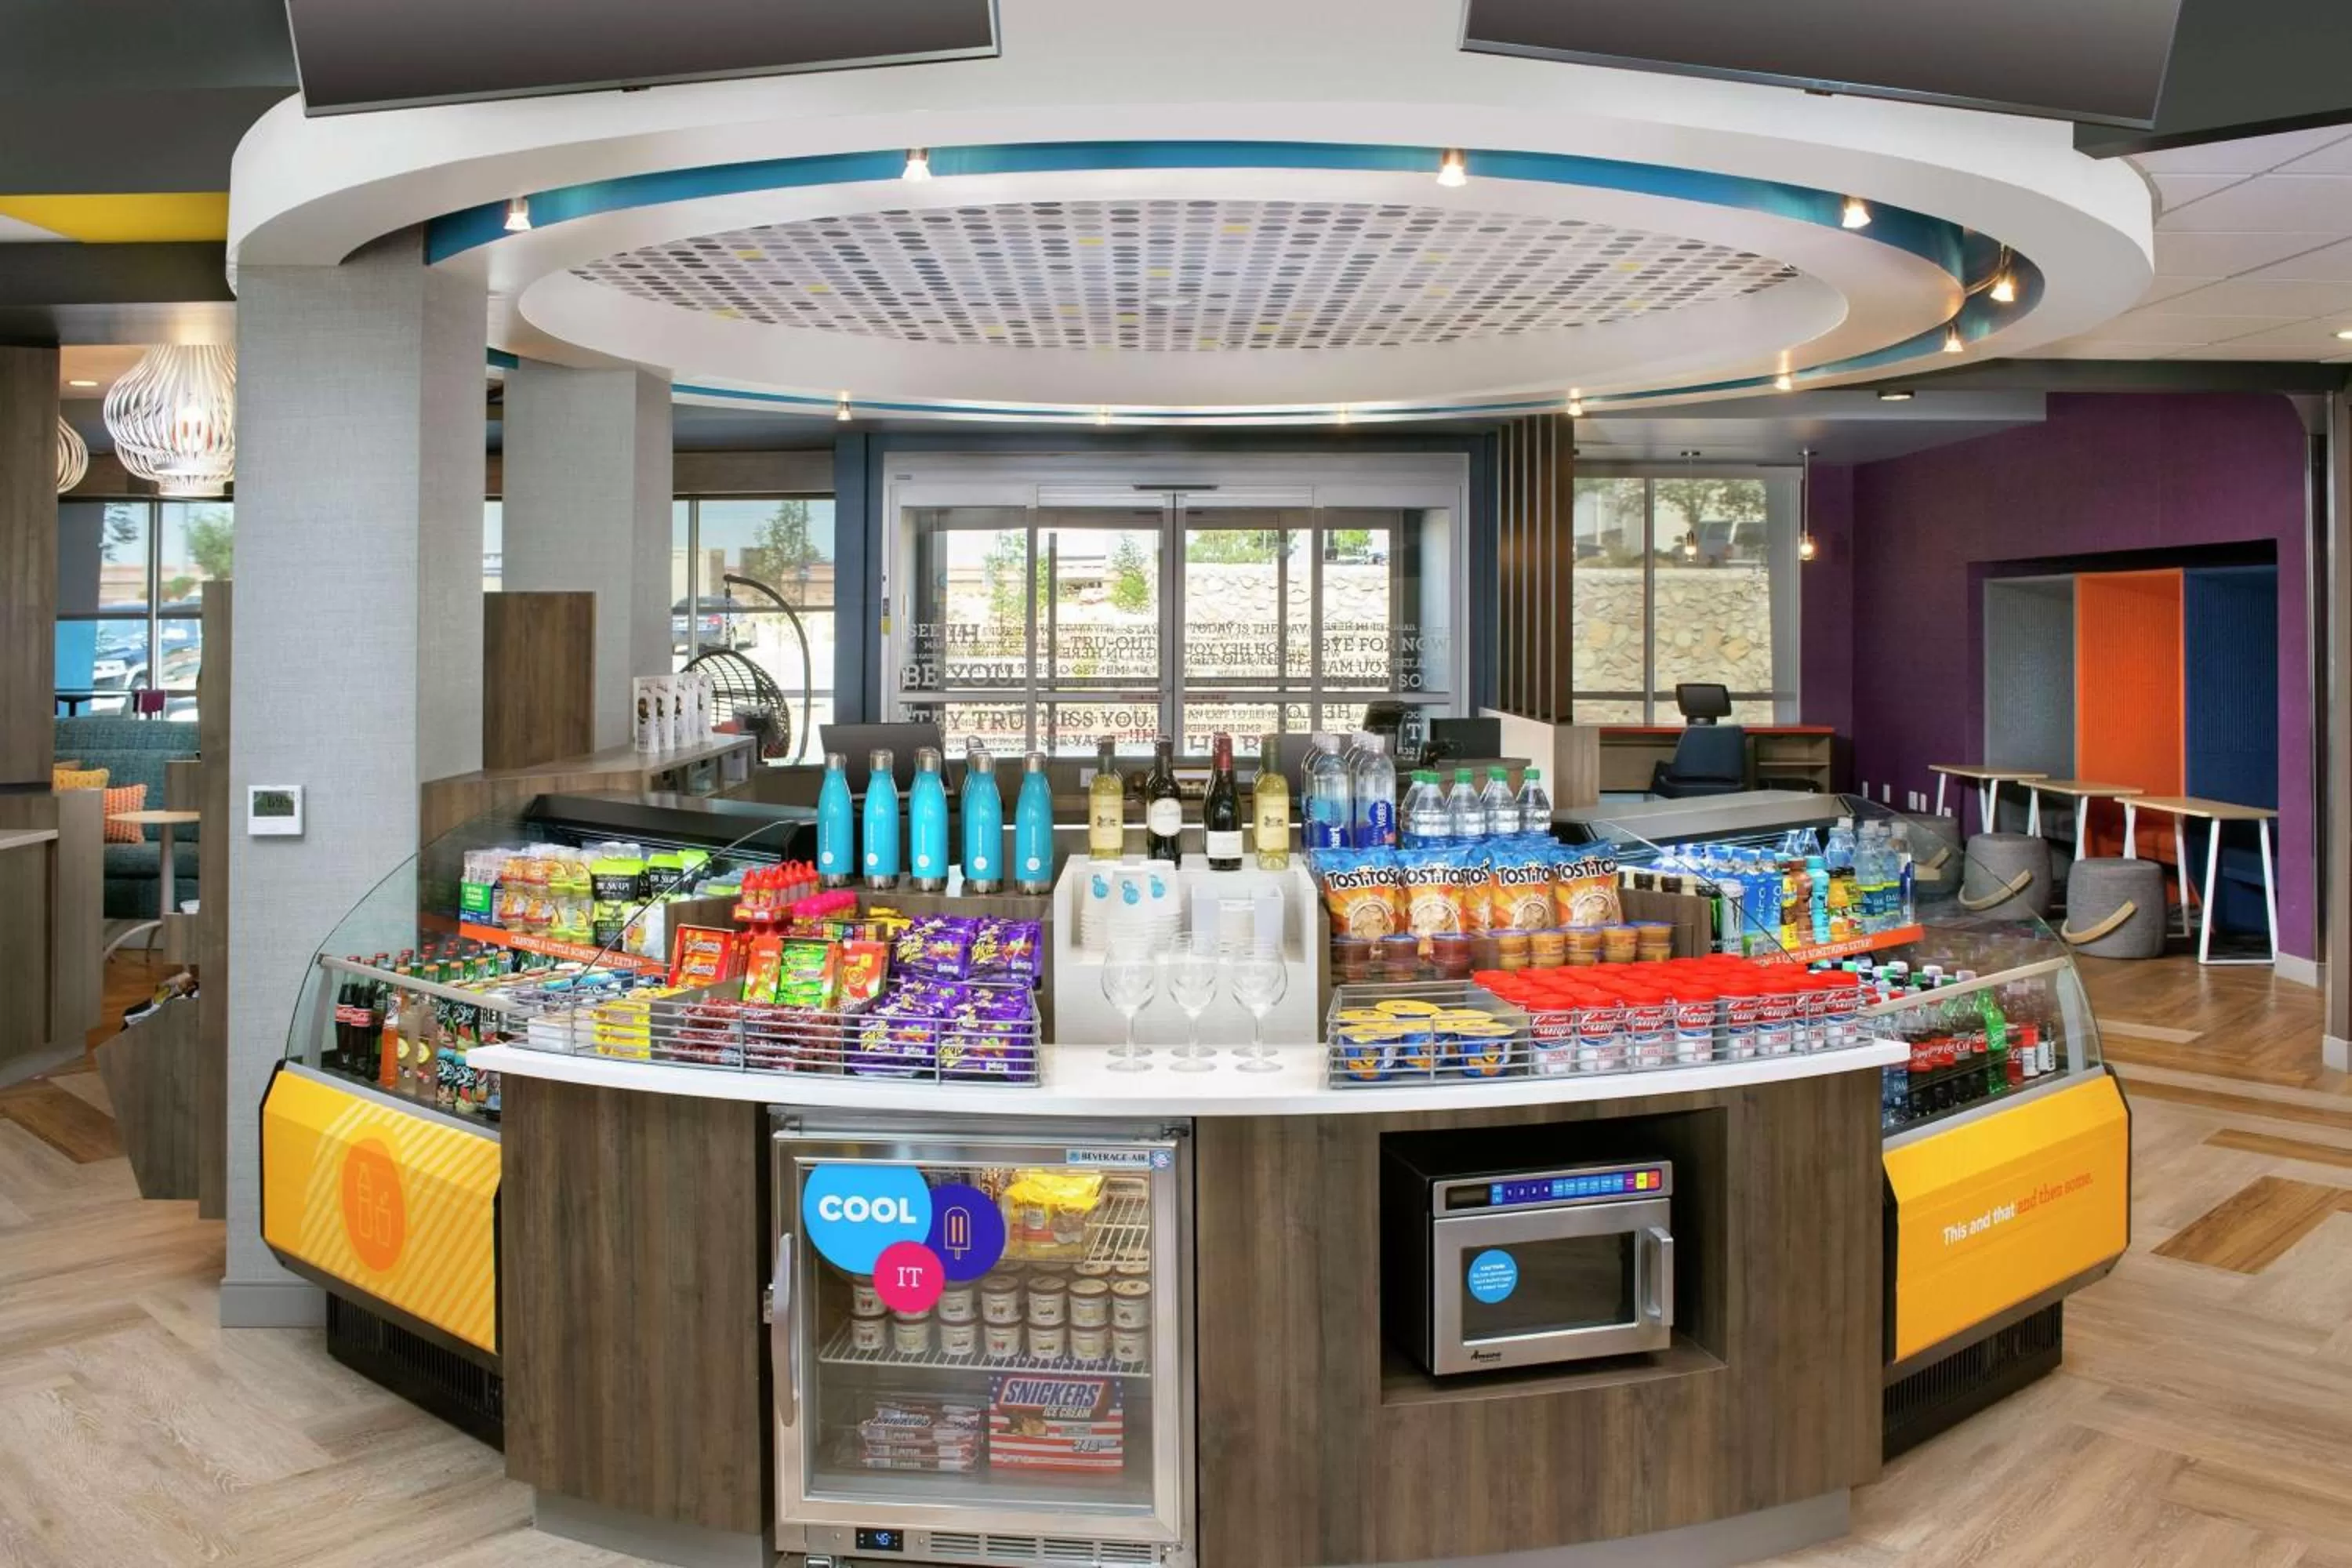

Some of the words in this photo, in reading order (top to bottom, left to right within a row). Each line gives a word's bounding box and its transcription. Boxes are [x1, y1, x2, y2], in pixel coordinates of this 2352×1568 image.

[904, 665, 939, 687] BE
[972, 710, 1025, 730] TRU
[818, 1195, 916, 1224] COOL
[1944, 1221, 1968, 1245] This
[1969, 1210, 1991, 1235] and
[1993, 1200, 2016, 1225] that
[2017, 1187, 2038, 1214] and
[896, 1266, 923, 1287] IT
[1004, 1379, 1099, 1407] SNICKERS
